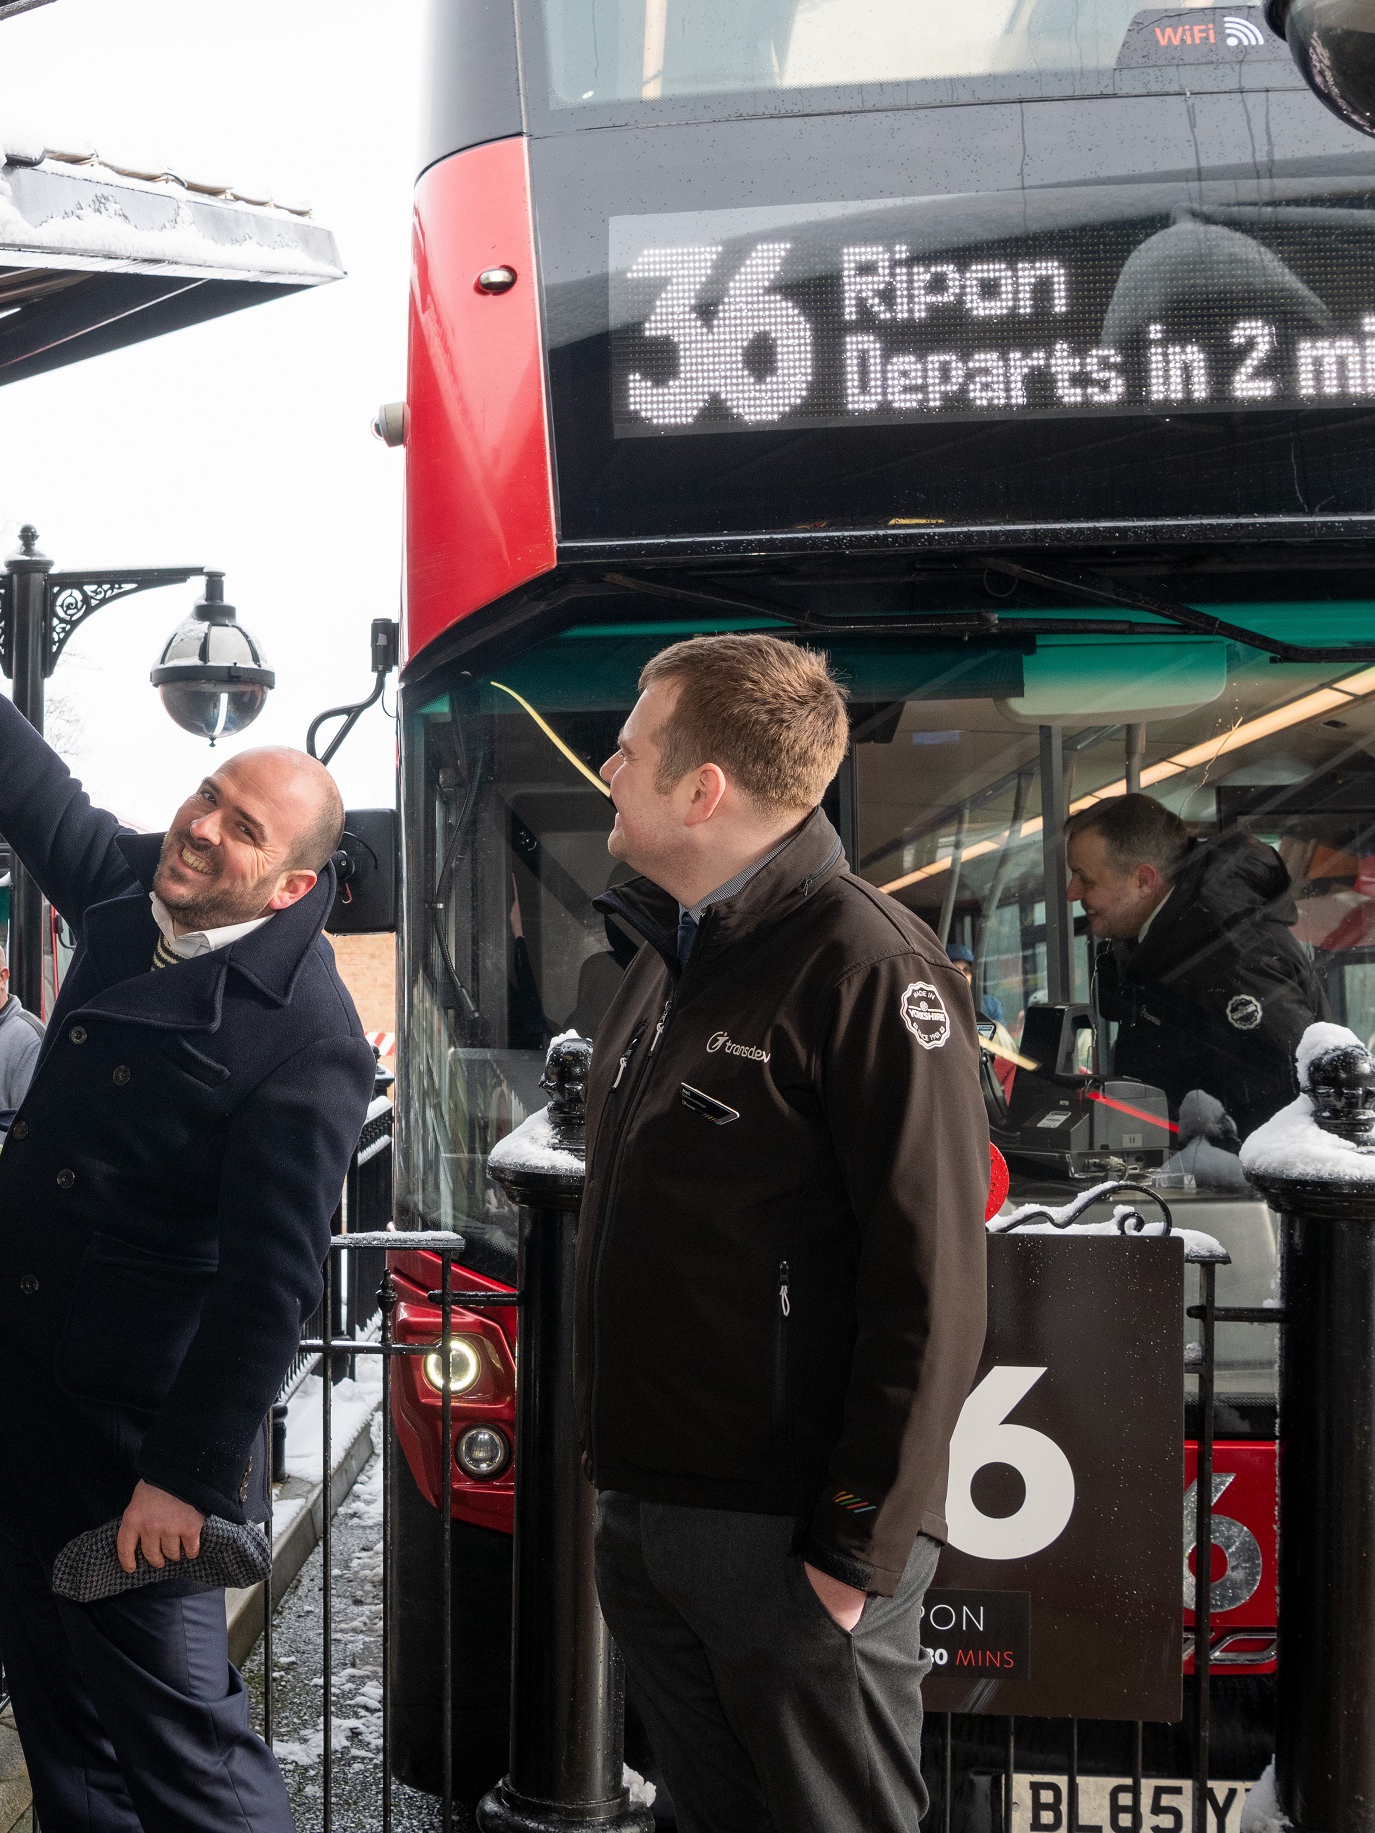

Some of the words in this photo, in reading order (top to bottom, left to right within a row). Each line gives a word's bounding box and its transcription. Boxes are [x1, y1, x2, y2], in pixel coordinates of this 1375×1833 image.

[1155, 24, 1216, 47] WiFi
[842, 242, 1069, 321] Ripon
[626, 242, 814, 425] 36
[845, 334, 1126, 411] Departs
[1148, 323, 1208, 402] in
[1231, 320, 1276, 398] 2
[908, 1009, 945, 1022] YORKSHIRE
[725, 1040, 771, 1063] transdev
[956, 1649, 1014, 1668] MINS
